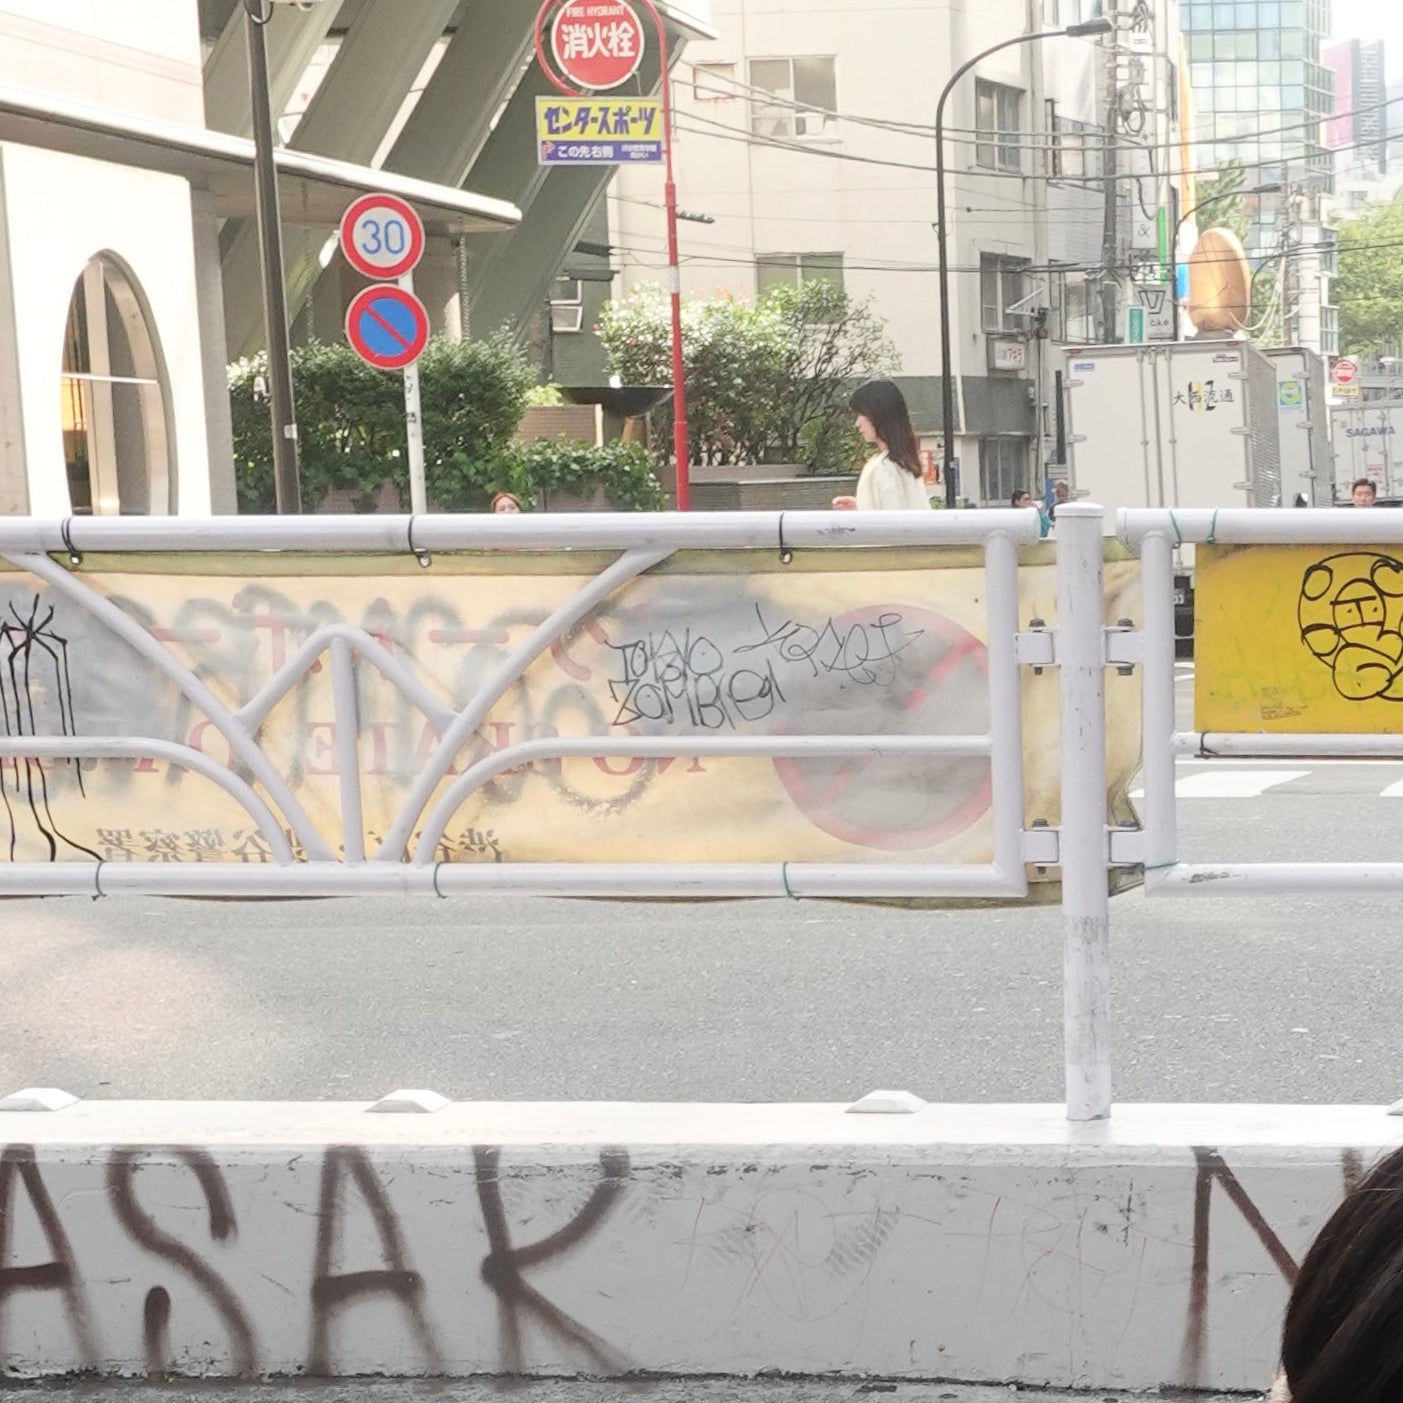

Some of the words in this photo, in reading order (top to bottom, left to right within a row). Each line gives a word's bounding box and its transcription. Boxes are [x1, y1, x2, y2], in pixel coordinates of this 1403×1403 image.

[566, 6, 585, 17] FIRE
[586, 5, 625, 17] HYDRANT
[561, 20, 636, 59] 消火栓
[544, 105, 656, 135] センタースポーツ
[557, 145, 614, 158] この先右側
[362, 219, 405, 255] 30
[1346, 425, 1396, 438] SAGAWA
